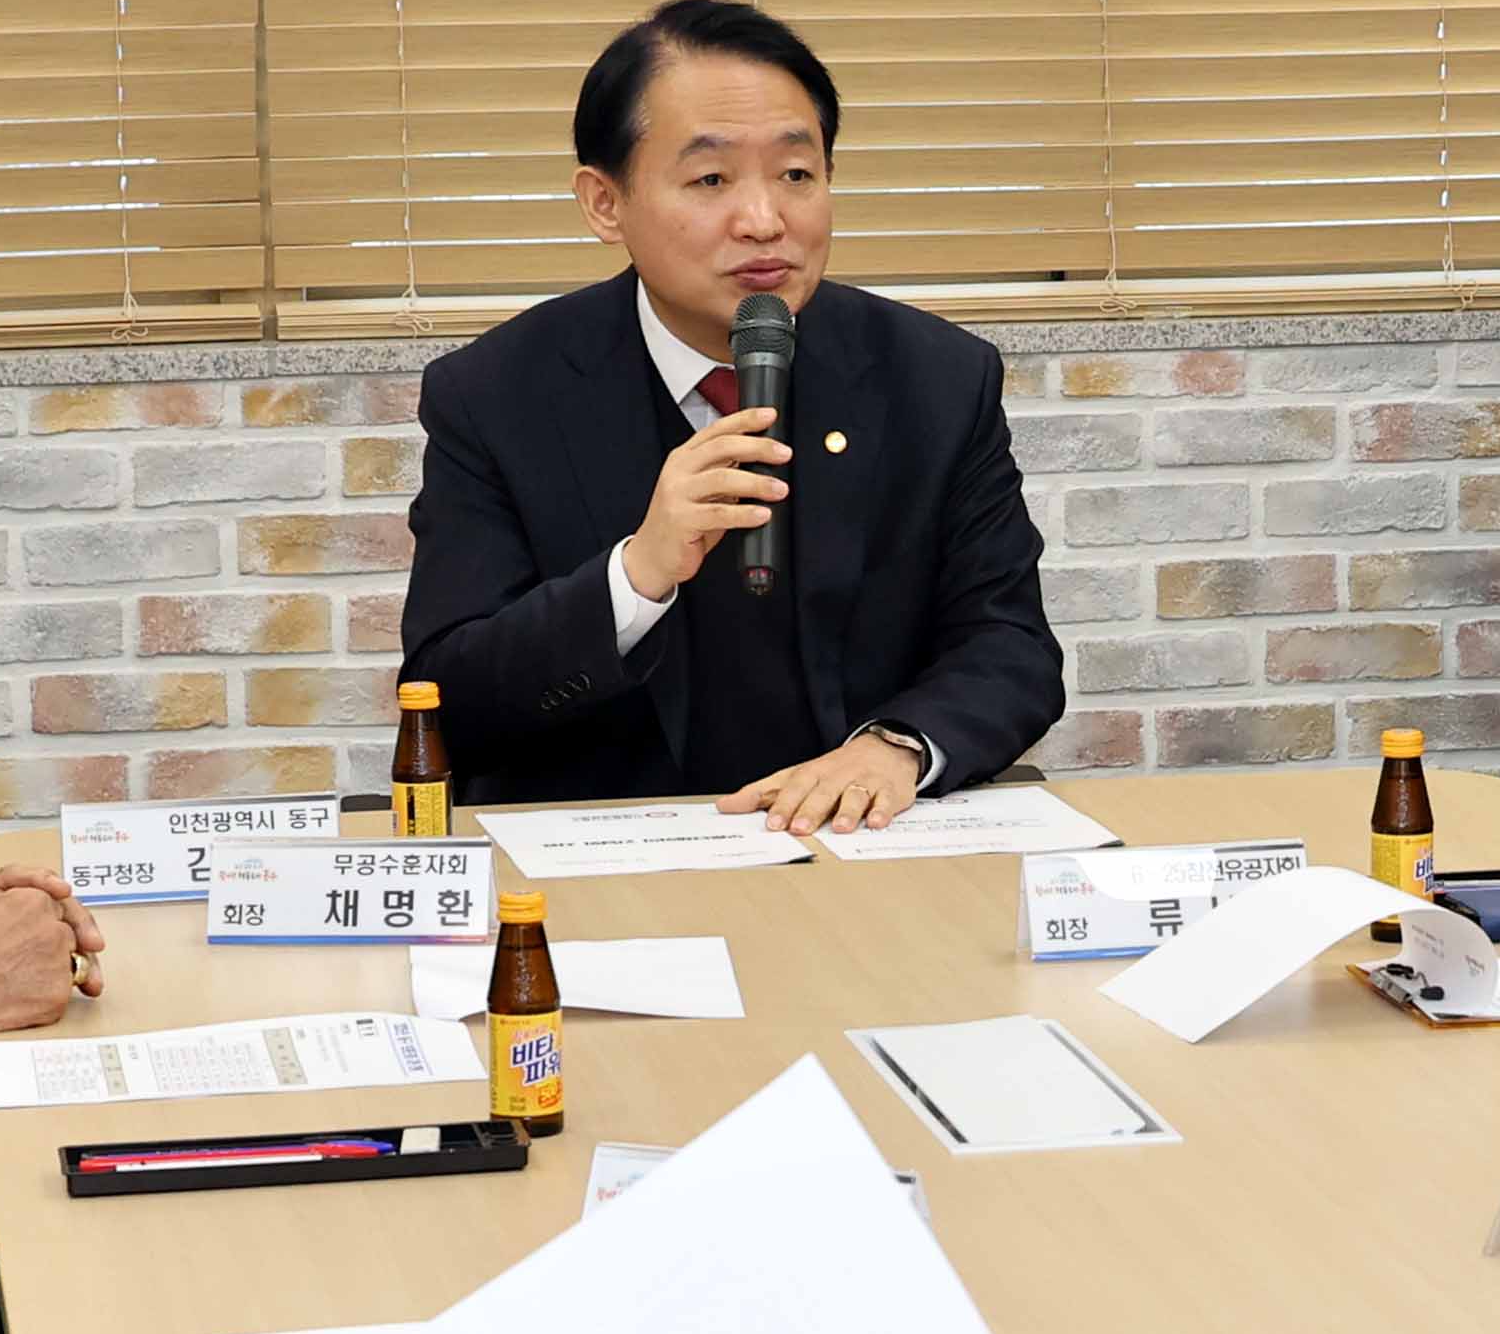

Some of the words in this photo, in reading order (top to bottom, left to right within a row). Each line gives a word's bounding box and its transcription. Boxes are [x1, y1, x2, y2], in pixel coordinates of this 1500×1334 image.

[168, 808, 276, 836] 인천광역시
[288, 808, 330, 830] 동구
[71, 862, 155, 888] 동구청장
[333, 853, 468, 876] 무공수훈자회
[222, 903, 265, 927] 회장
[1045, 918, 1089, 941] 회장
[511, 1032, 554, 1066] 비타
